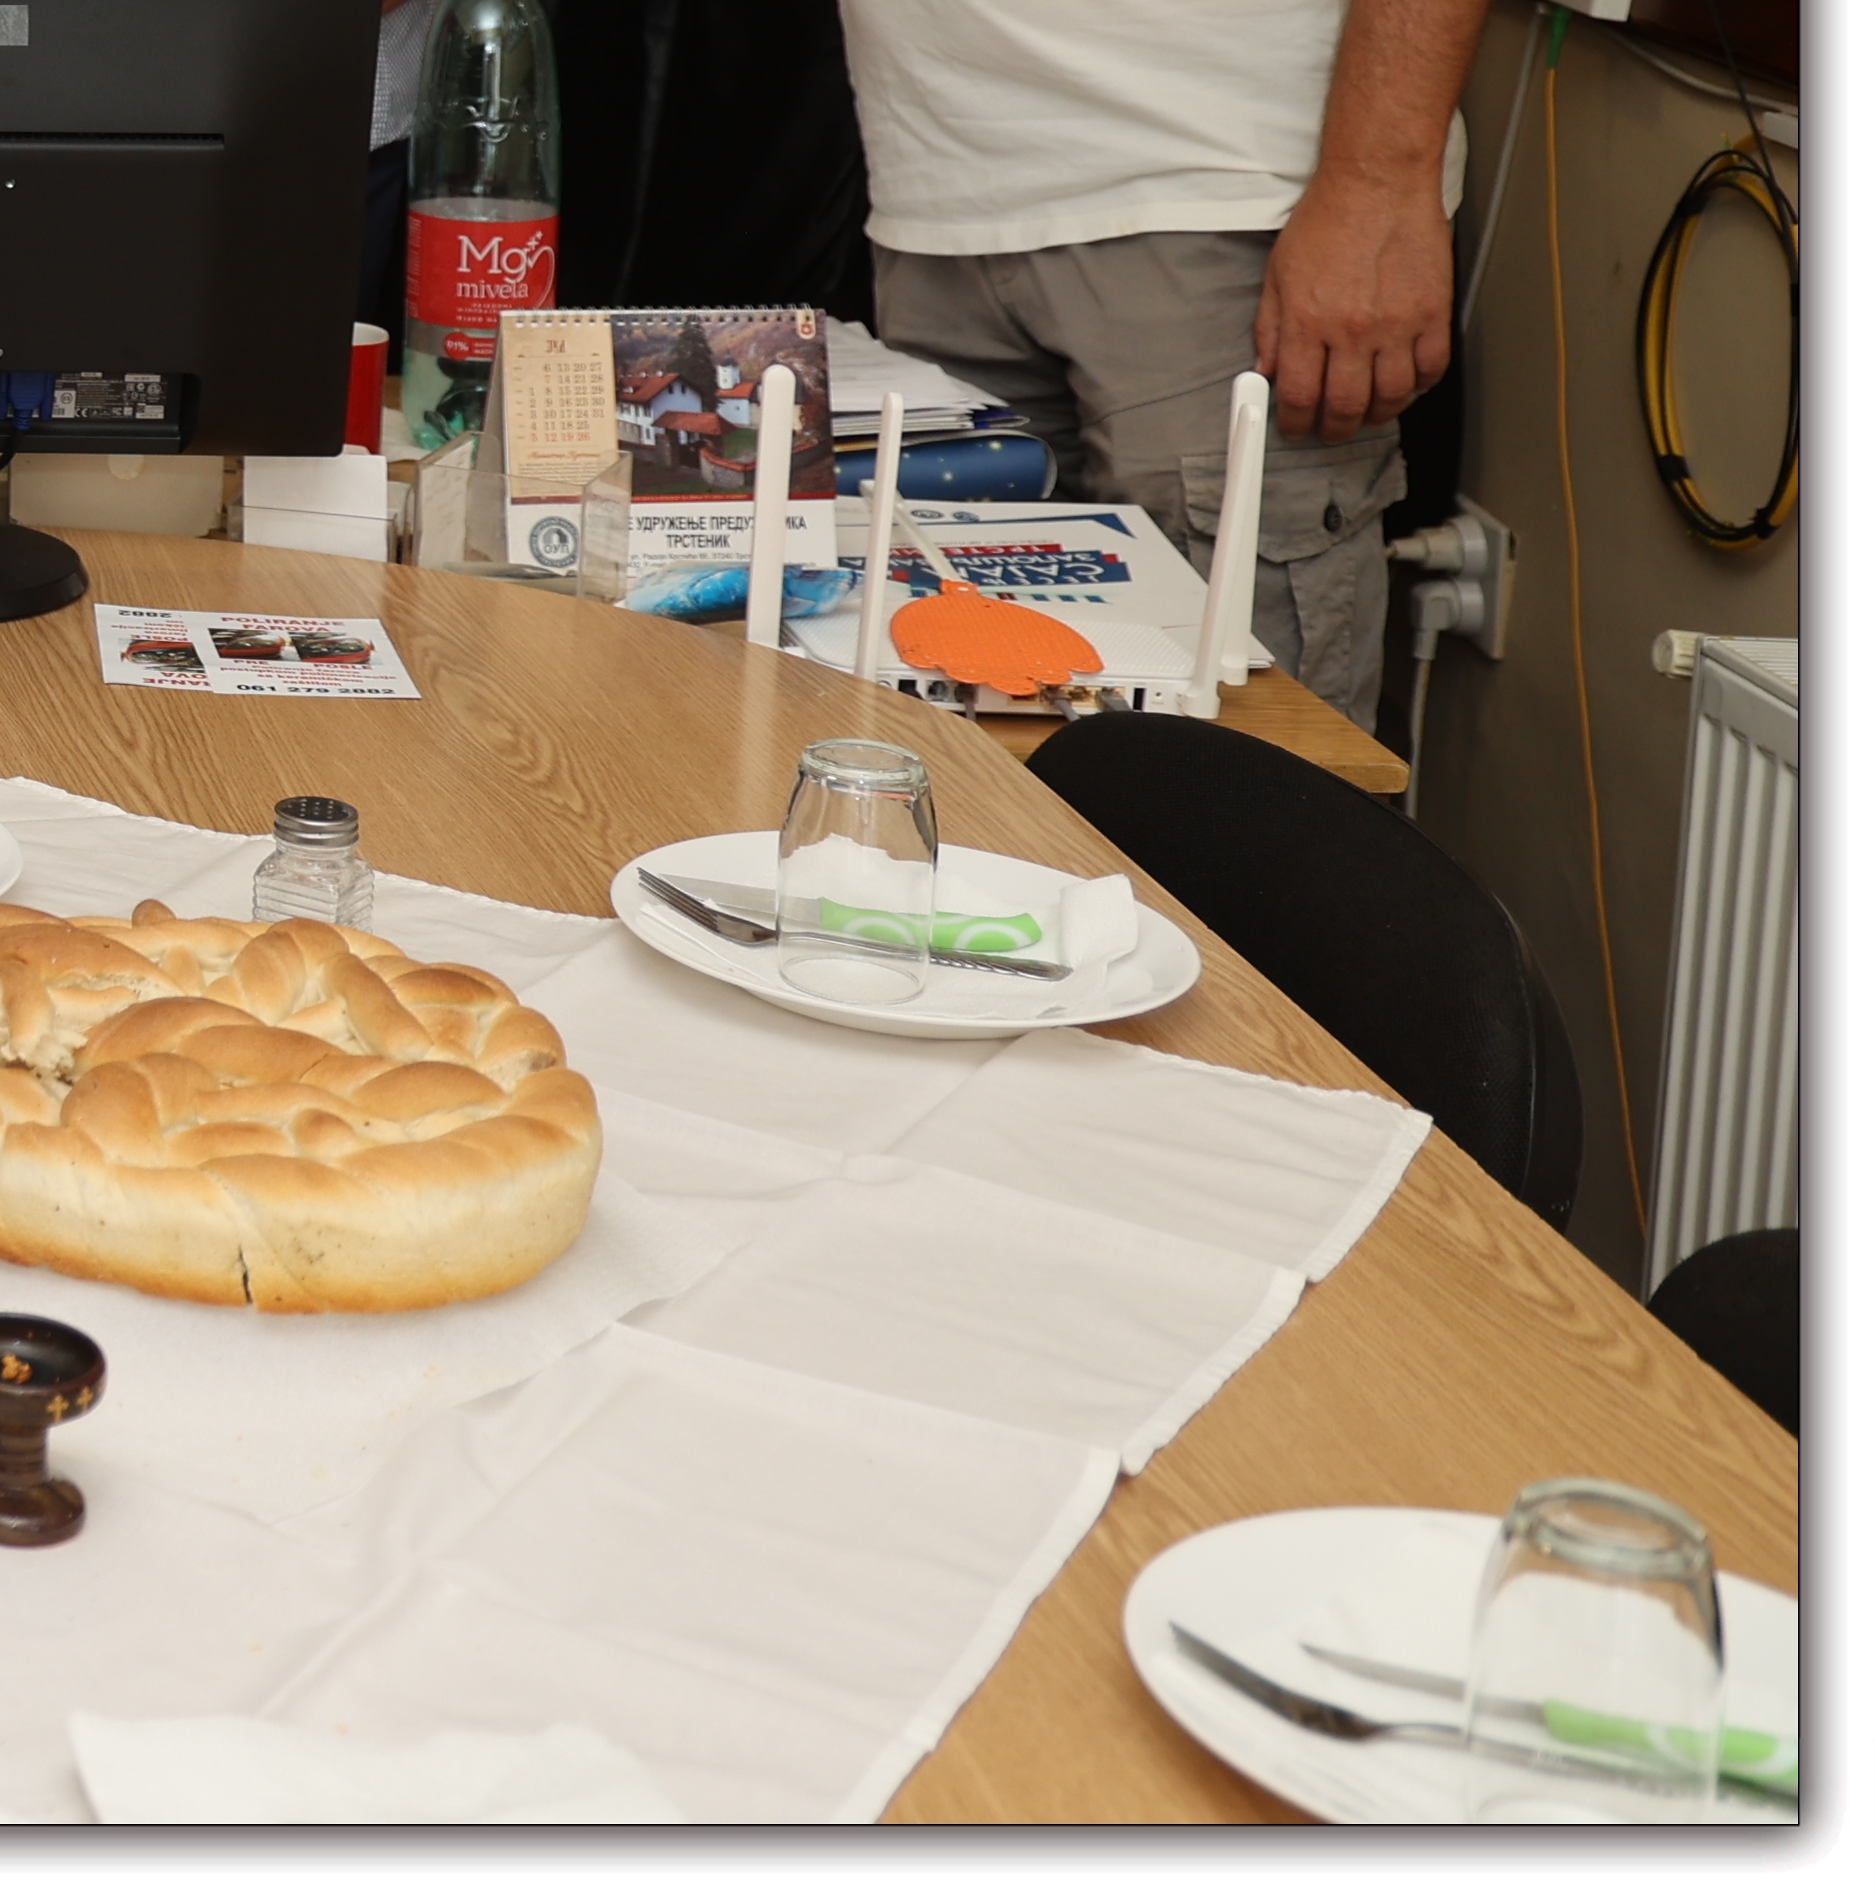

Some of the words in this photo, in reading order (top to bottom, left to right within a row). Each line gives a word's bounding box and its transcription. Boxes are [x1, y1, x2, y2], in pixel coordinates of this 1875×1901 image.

[457, 234, 529, 283] Mg
[456, 280, 529, 299] mivela
[636, 516, 707, 532] УДРУЖЕЊЕ
[666, 534, 731, 548] ТРСТЕНИК
[221, 617, 346, 627] POLIRANJE
[243, 624, 330, 632] FAROVA
[314, 663, 373, 671] POSLE
[237, 684, 277, 692] 061
[287, 686, 330, 694] 279
